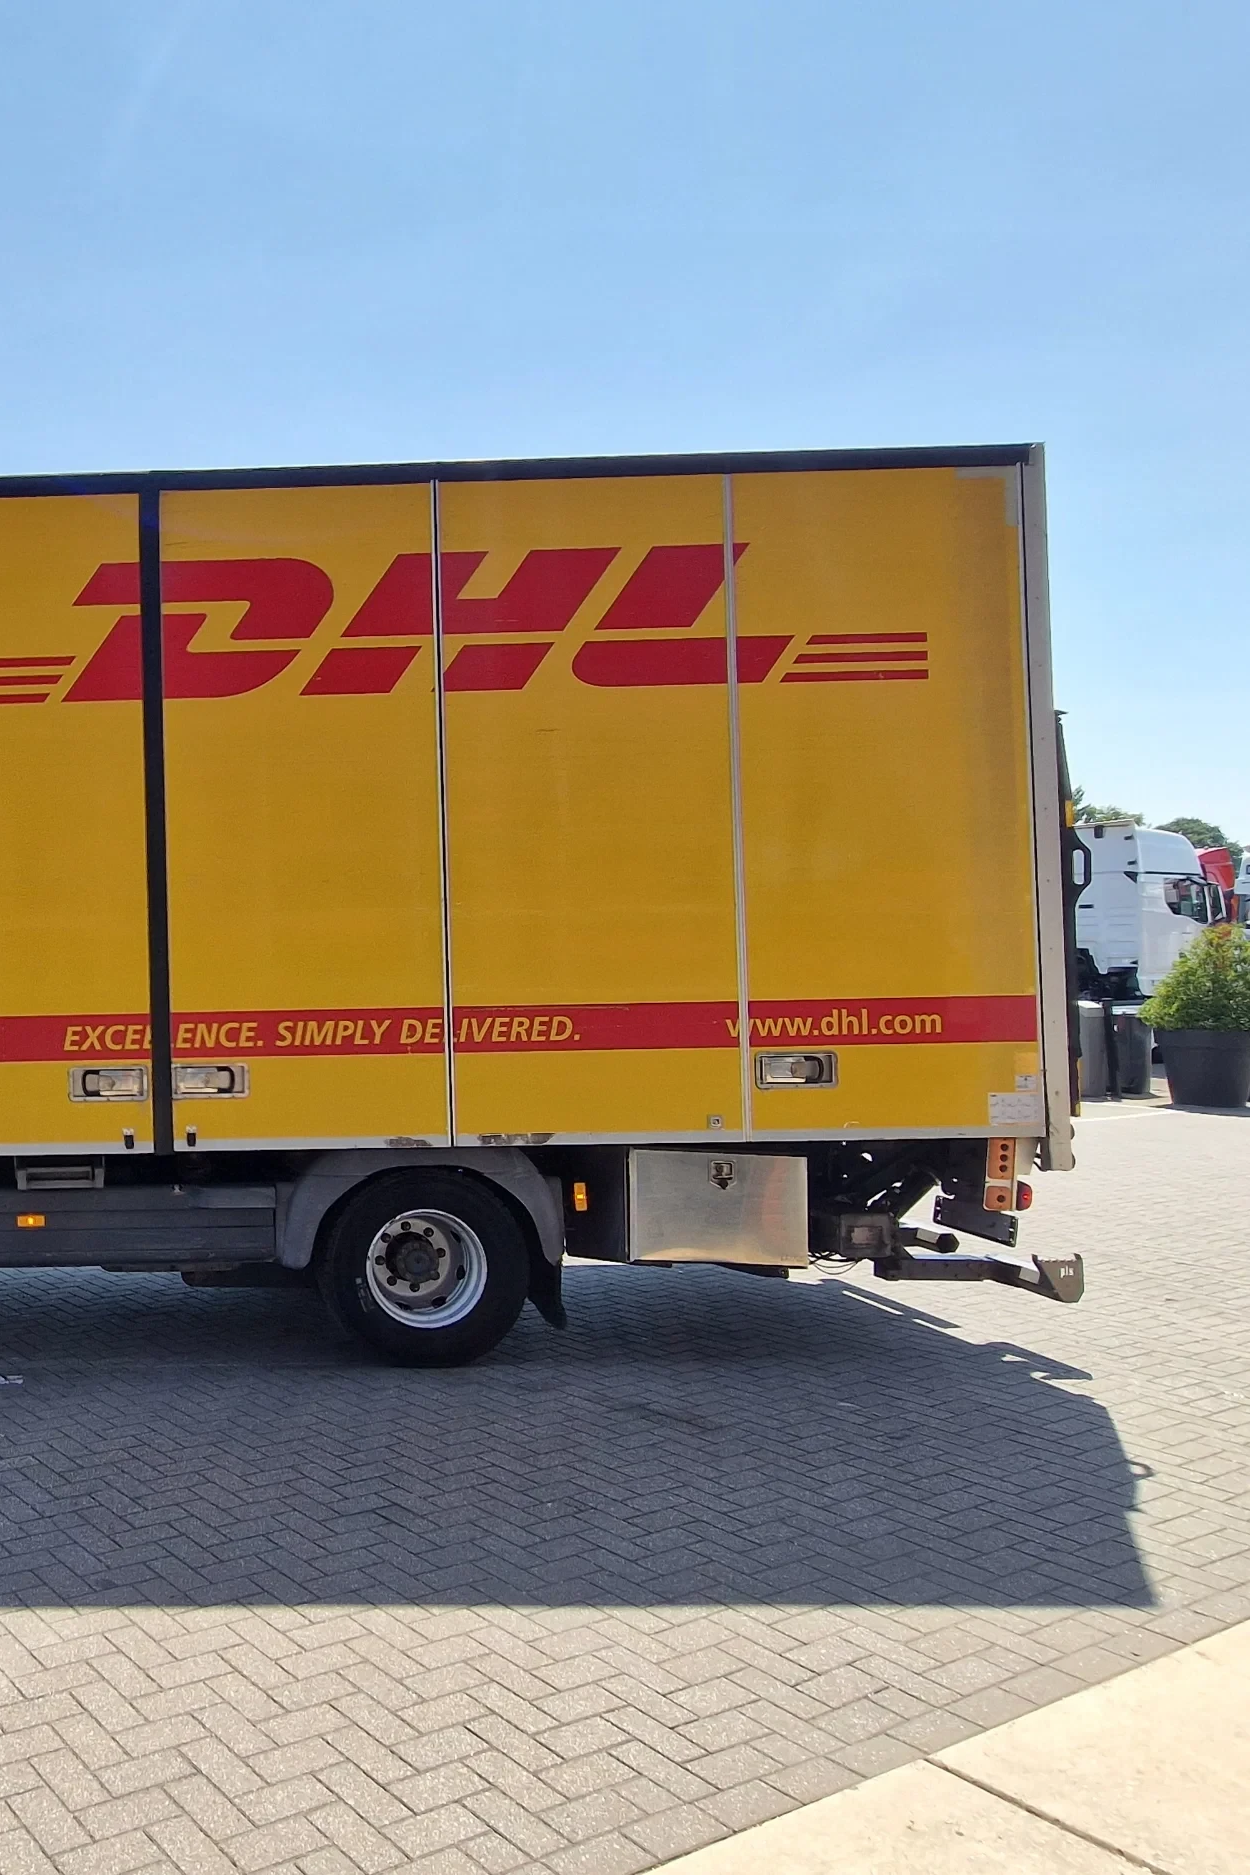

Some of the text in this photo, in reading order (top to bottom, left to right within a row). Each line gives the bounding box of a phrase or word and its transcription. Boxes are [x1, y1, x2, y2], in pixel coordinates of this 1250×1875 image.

[61, 542, 794, 702] DHL
[63, 1021, 264, 1051] EXCELENCE.
[275, 1018, 392, 1047] SIMPLY
[725, 1008, 943, 1038] www.dhl.com
